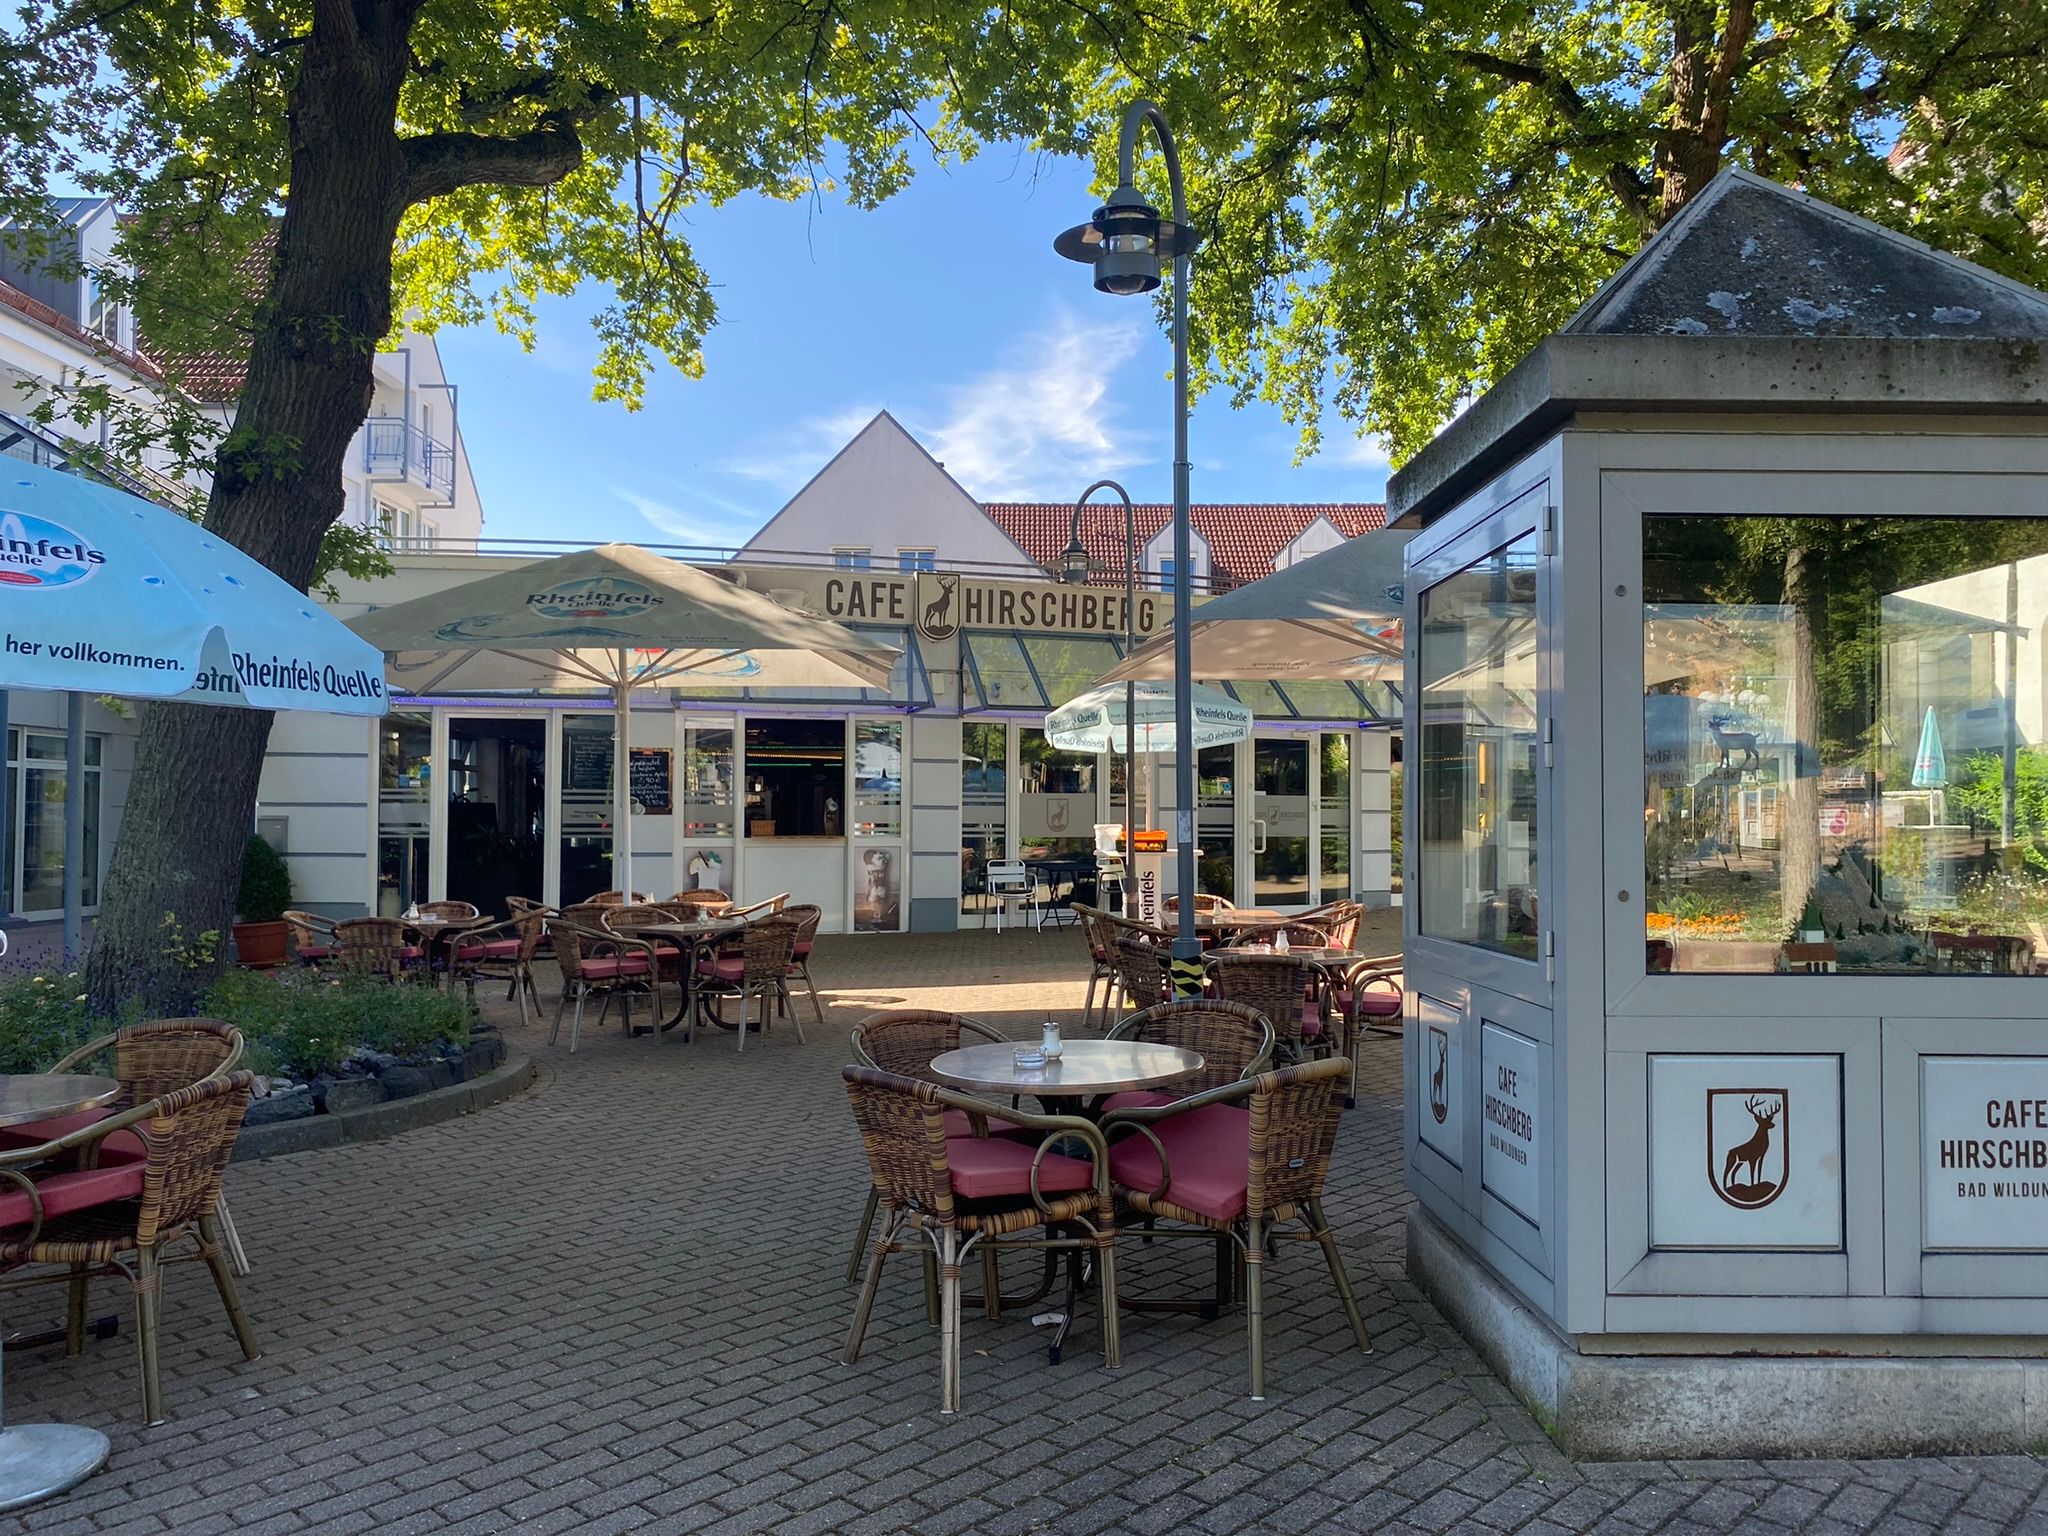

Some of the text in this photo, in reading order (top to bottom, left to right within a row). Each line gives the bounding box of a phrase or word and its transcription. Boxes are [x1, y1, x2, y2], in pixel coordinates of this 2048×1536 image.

[525, 591, 664, 606] Rheinfels
[825, 579, 905, 619] CAFE
[6, 634, 185, 671] her vollkommen.
[232, 652, 382, 698] Rheinfels Quelle
[1196, 707, 1247, 722] Rheinfels Quelle
[1498, 1065, 1517, 1098] CAFE
[1485, 1093, 1532, 1142] HIRSCHBERG
[1987, 1099, 2048, 1128] CAFE
[1490, 1133, 1527, 1166] BAD WILDUNGEN
[1940, 1139, 2048, 1168] HIRSCHB
[1958, 1182, 2048, 1198] BAD WILDUN
